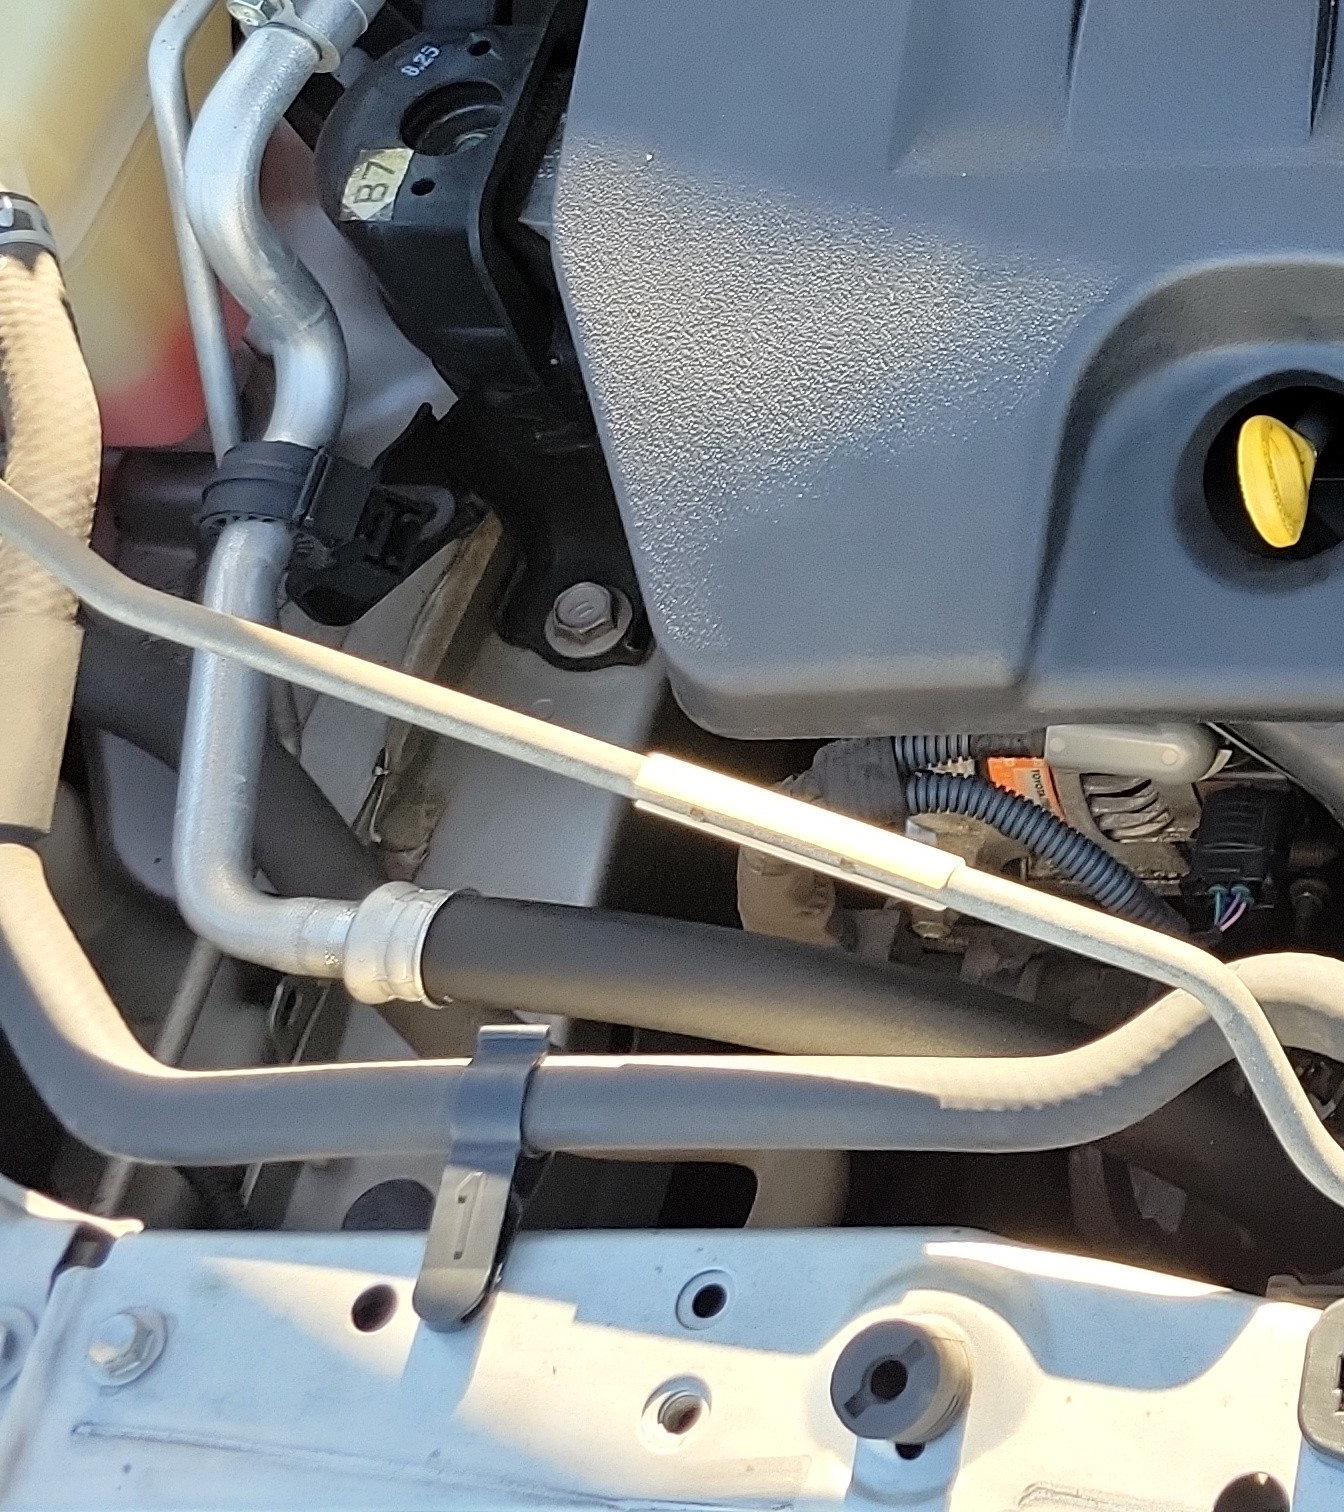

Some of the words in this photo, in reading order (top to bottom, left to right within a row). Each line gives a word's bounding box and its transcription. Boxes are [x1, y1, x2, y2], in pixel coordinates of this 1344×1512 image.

[401, 44, 440, 78] 8.25
[354, 159, 397, 204] B7
[1031, 770, 1046, 799] TOYOTA
